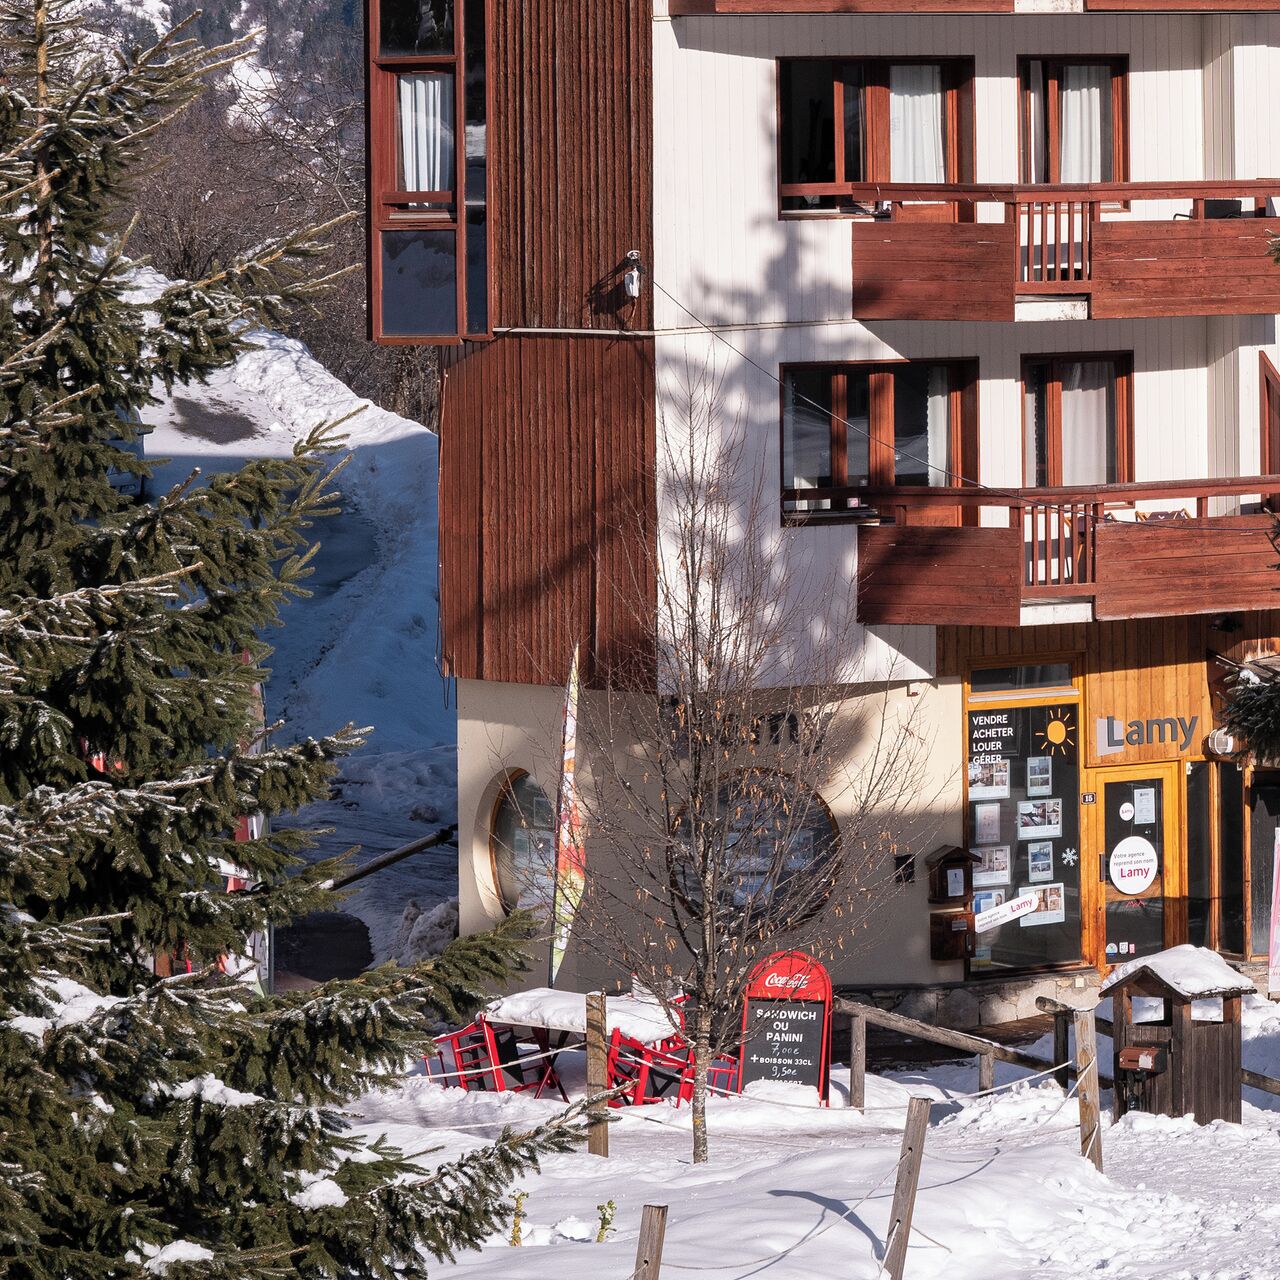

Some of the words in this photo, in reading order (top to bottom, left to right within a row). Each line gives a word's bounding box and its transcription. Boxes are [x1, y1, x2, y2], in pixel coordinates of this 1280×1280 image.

[972, 714, 1008, 726] VENDRE
[972, 727, 1014, 739] ACHETER
[1106, 715, 1199, 752] Lamy
[972, 741, 1002, 752] LOUER
[972, 753, 1002, 765] GÉRER
[1120, 867, 1150, 879] Lamy
[1010, 898, 1033, 913] Lamy
[756, 1009, 817, 1021] SANDWICH
[773, 1021, 789, 1031] OU
[766, 1032, 803, 1043] PANINI
[794, 1058, 813, 1066] 33CL
